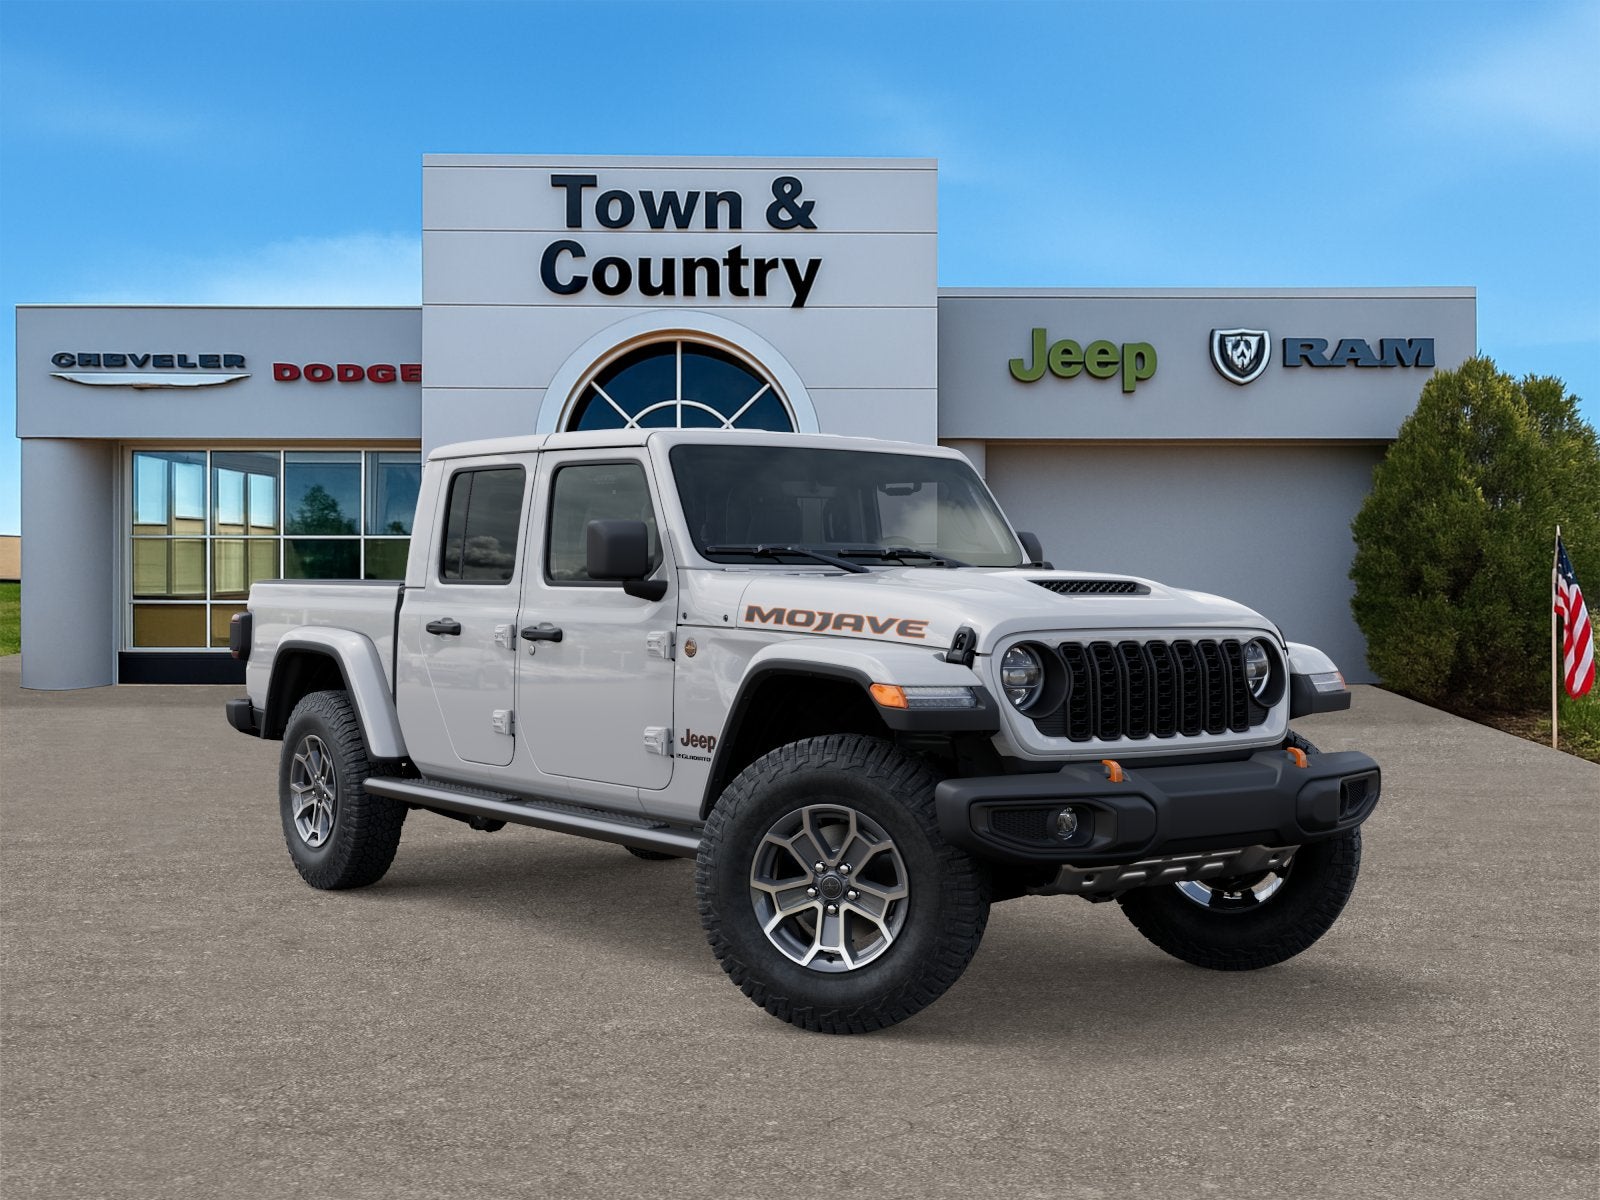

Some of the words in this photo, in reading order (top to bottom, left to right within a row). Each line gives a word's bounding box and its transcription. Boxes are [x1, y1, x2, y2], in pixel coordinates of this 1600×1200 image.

[551, 174, 743, 229] Town
[765, 176, 818, 230] &
[540, 239, 822, 308] Country
[1009, 328, 1157, 393] Jeep
[1282, 337, 1436, 368] RAM
[273, 363, 422, 383] DODGE
[744, 605, 929, 639] MOJAVE
[680, 728, 717, 753] Jeep
